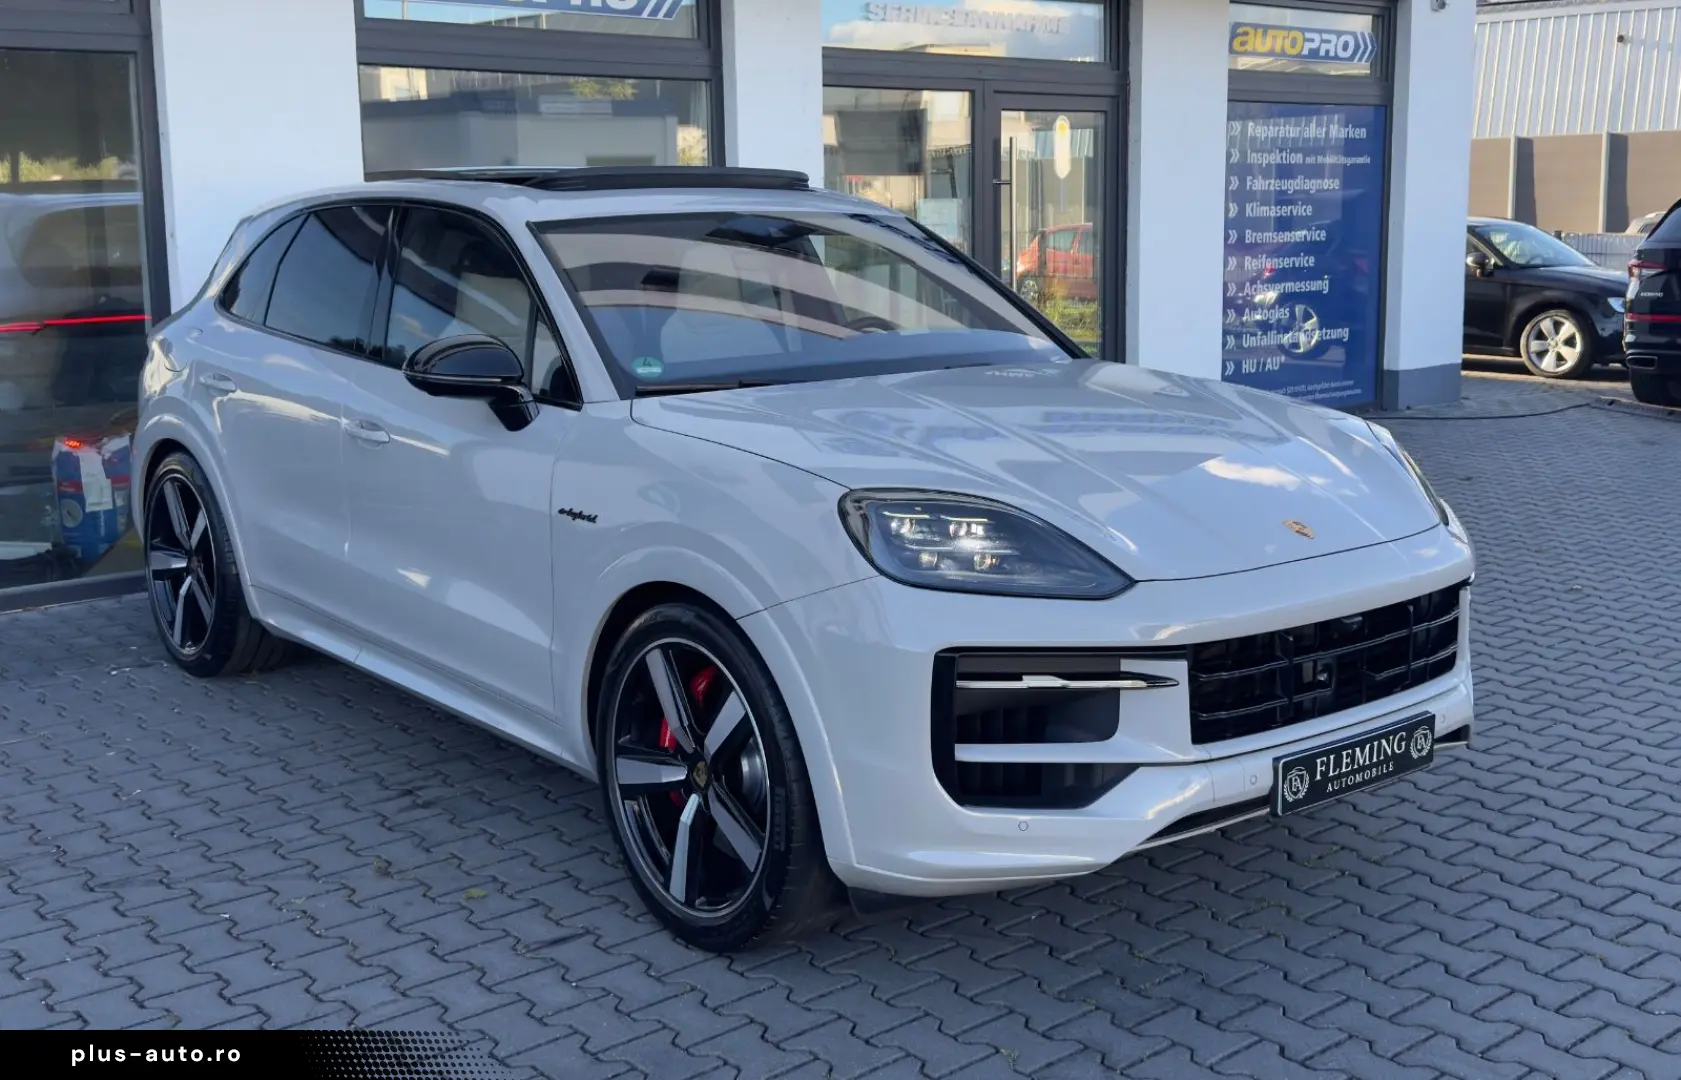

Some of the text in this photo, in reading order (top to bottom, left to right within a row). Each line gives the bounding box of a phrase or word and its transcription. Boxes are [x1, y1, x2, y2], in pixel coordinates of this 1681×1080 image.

[1247, 122, 1367, 141] Reparatur aller Marken
[1247, 149, 1303, 167] Inspektion
[1246, 176, 1340, 193] Fahrzeugdiagnose
[1245, 201, 1313, 217] Klimaservice
[1245, 226, 1326, 244] Bremsenservice
[1244, 252, 1315, 270] Reifenservice
[1243, 279, 1329, 296] Achsvermessung
[1243, 307, 1290, 323] Autoglas
[1242, 359, 1257, 374] HU
[1314, 731, 1407, 781] FLEMING
[1326, 761, 1395, 793] AUTOMOBILE
